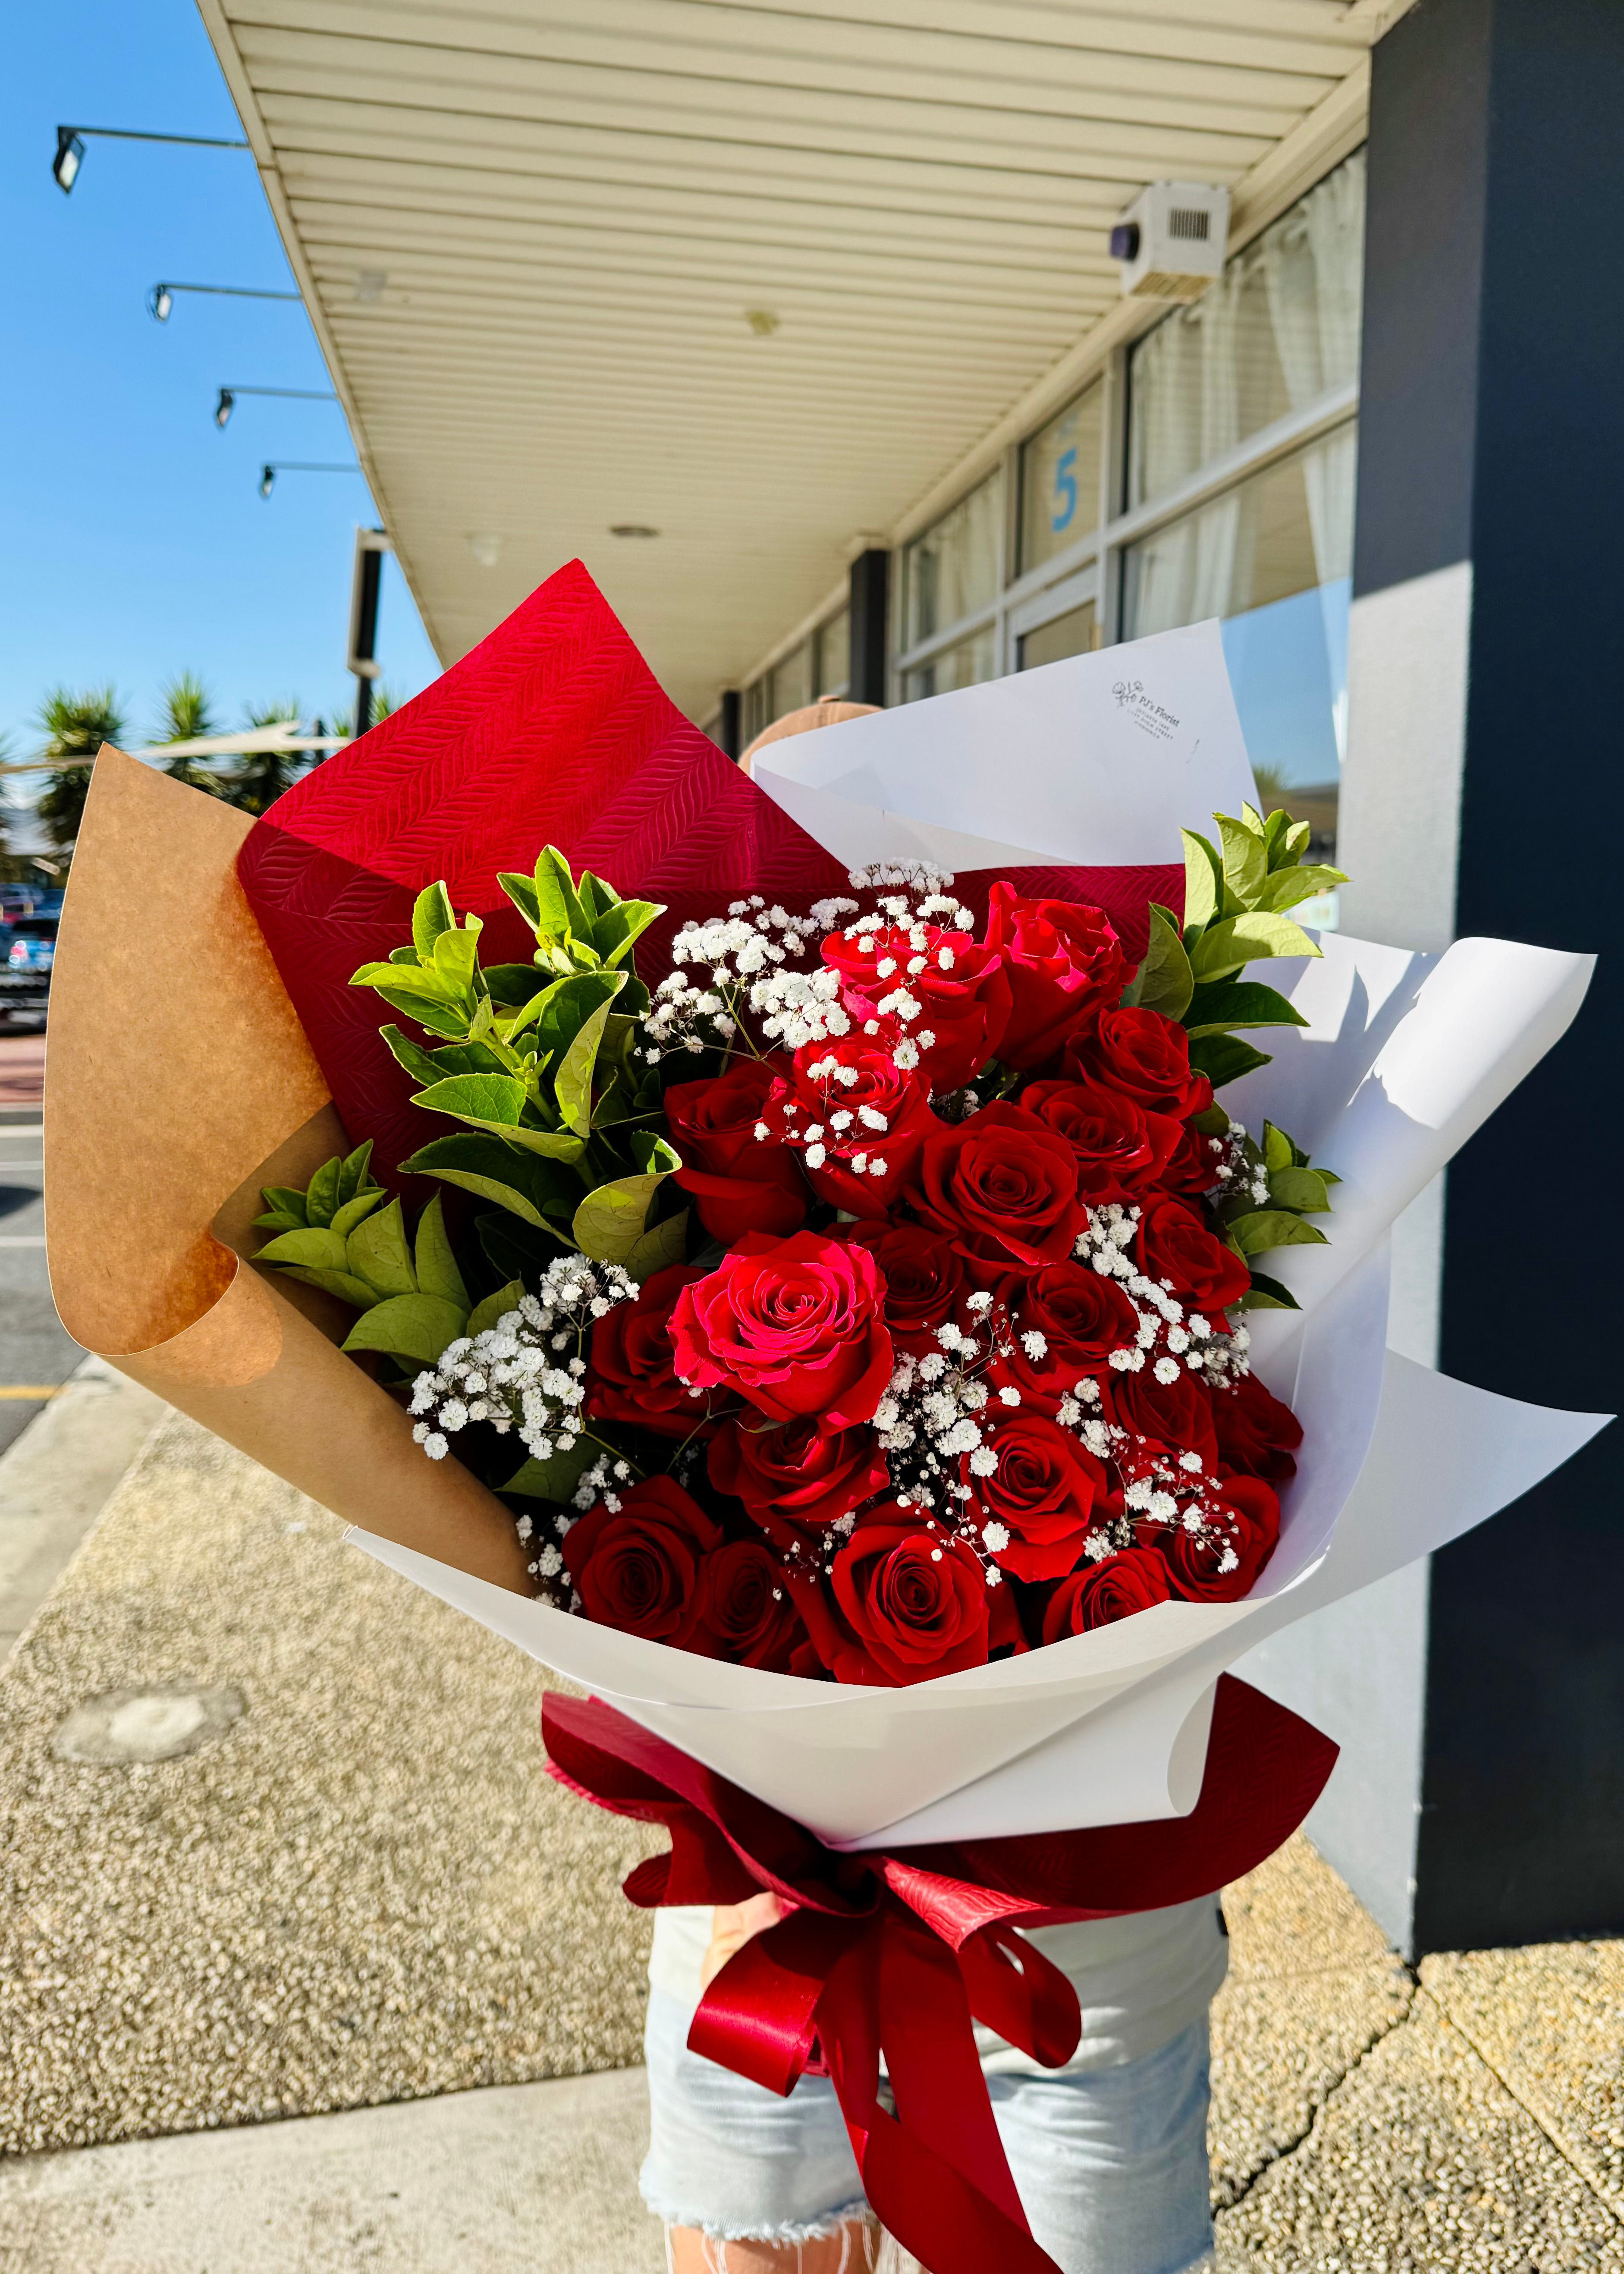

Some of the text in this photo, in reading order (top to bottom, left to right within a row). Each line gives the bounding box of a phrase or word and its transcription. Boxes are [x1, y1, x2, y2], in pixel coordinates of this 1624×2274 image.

[1052, 447, 1077, 533] 5
[1139, 696, 1154, 711] PJ's
[1155, 706, 1180, 727] Florist
